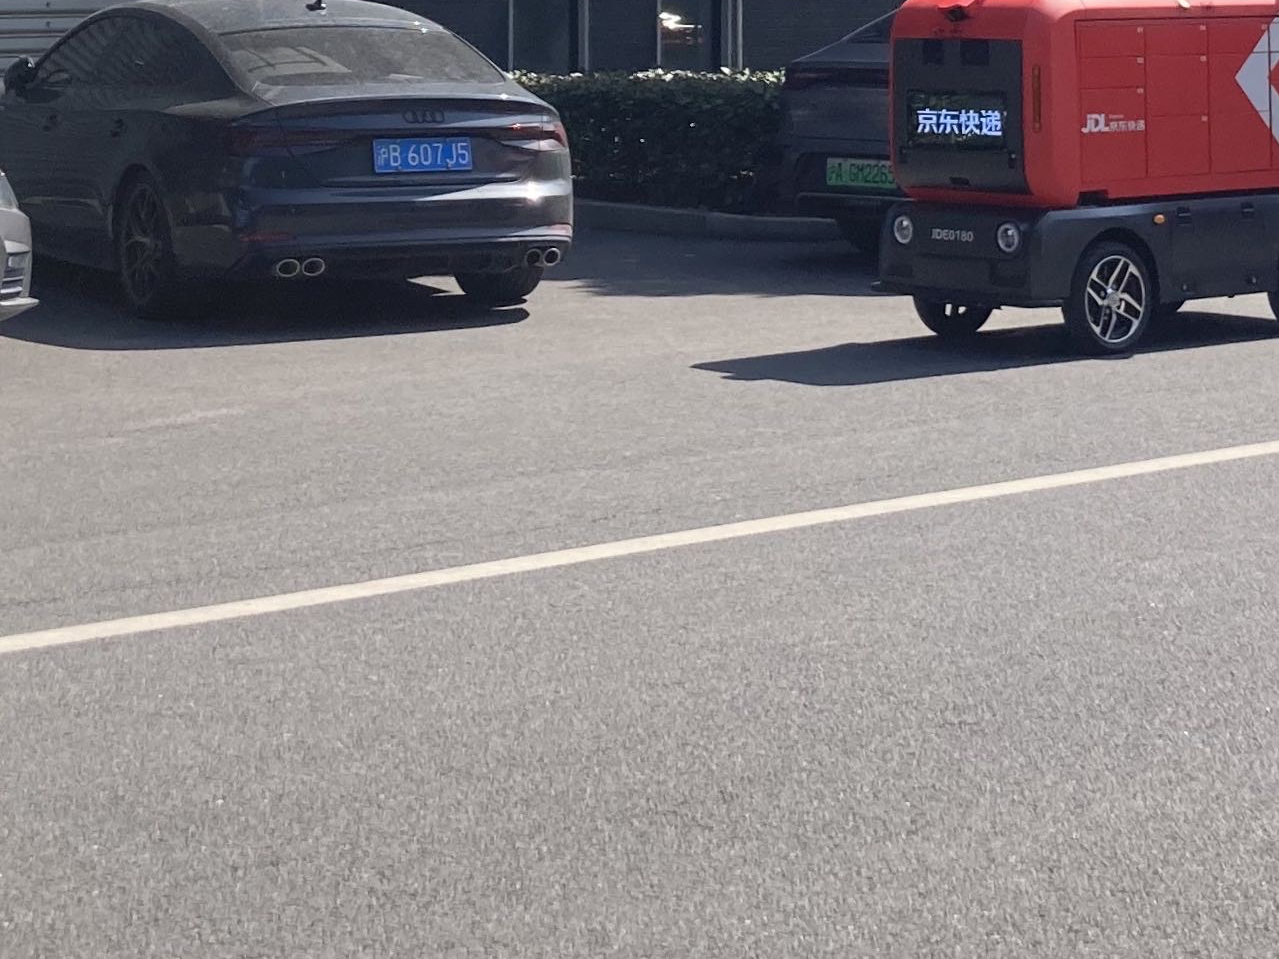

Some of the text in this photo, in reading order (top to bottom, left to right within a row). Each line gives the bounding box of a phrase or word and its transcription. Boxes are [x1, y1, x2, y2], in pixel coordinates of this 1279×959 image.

[916, 108, 1002, 136] 京东快递
[1081, 113, 1109, 133] JDL
